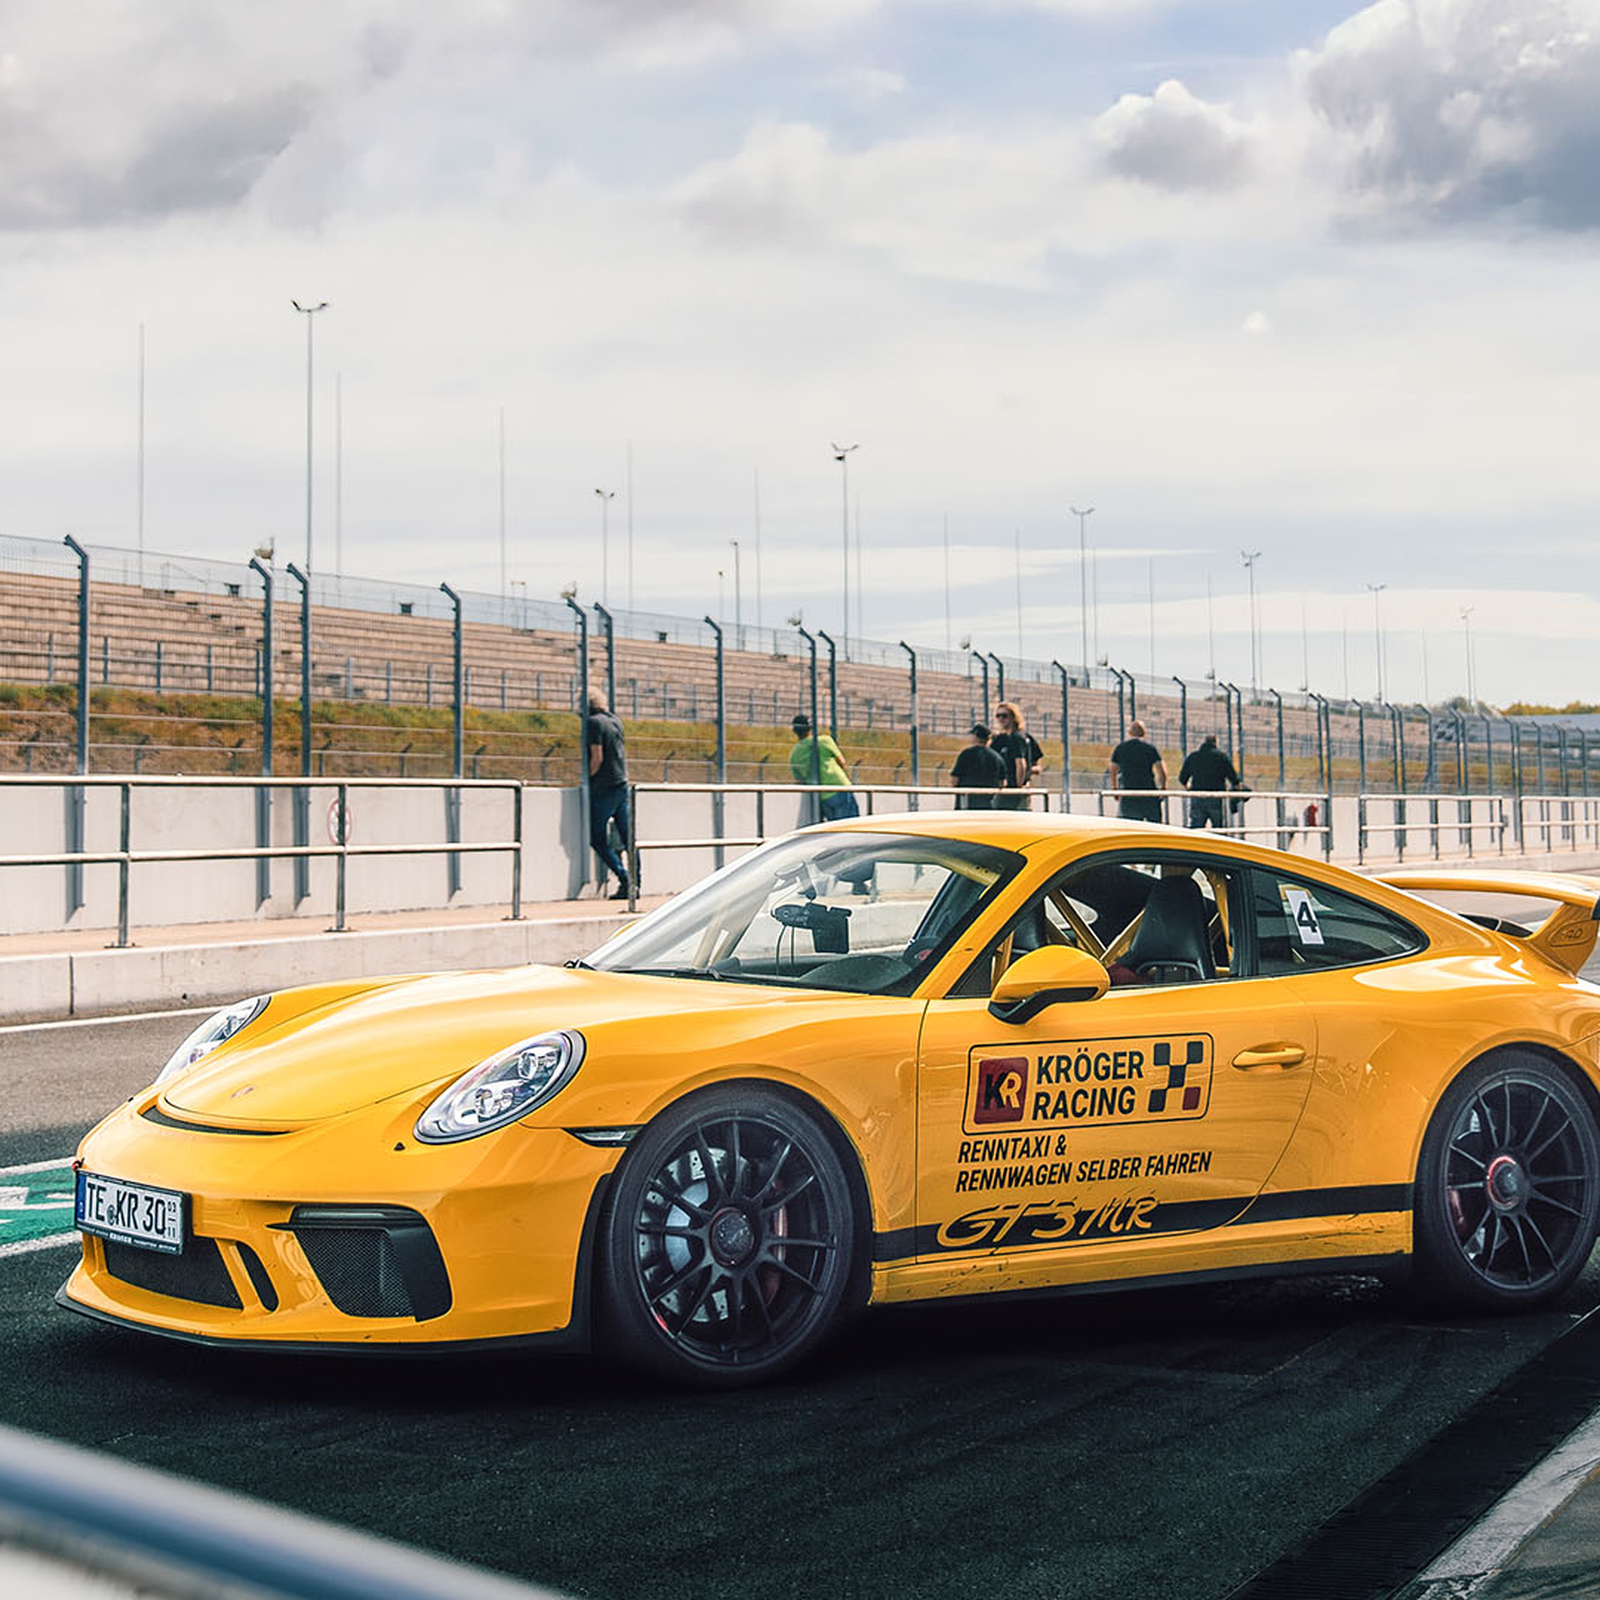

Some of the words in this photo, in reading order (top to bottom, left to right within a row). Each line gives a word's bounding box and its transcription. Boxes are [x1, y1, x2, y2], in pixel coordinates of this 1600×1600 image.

[1297, 901, 1318, 933] 4
[1036, 1047, 1145, 1085] KRÖGER
[983, 1071, 1023, 1110] KR
[1031, 1086, 1136, 1121] RACING
[957, 1135, 1051, 1164] RENNTAXI
[1054, 1134, 1067, 1156] &
[955, 1162, 1073, 1193] RENNWAGEN
[1076, 1157, 1142, 1183] SELBER
[1144, 1151, 1213, 1177] FAHREN
[87, 1182, 107, 1222] TE
[115, 1189, 139, 1230] KR
[142, 1195, 166, 1235] 30
